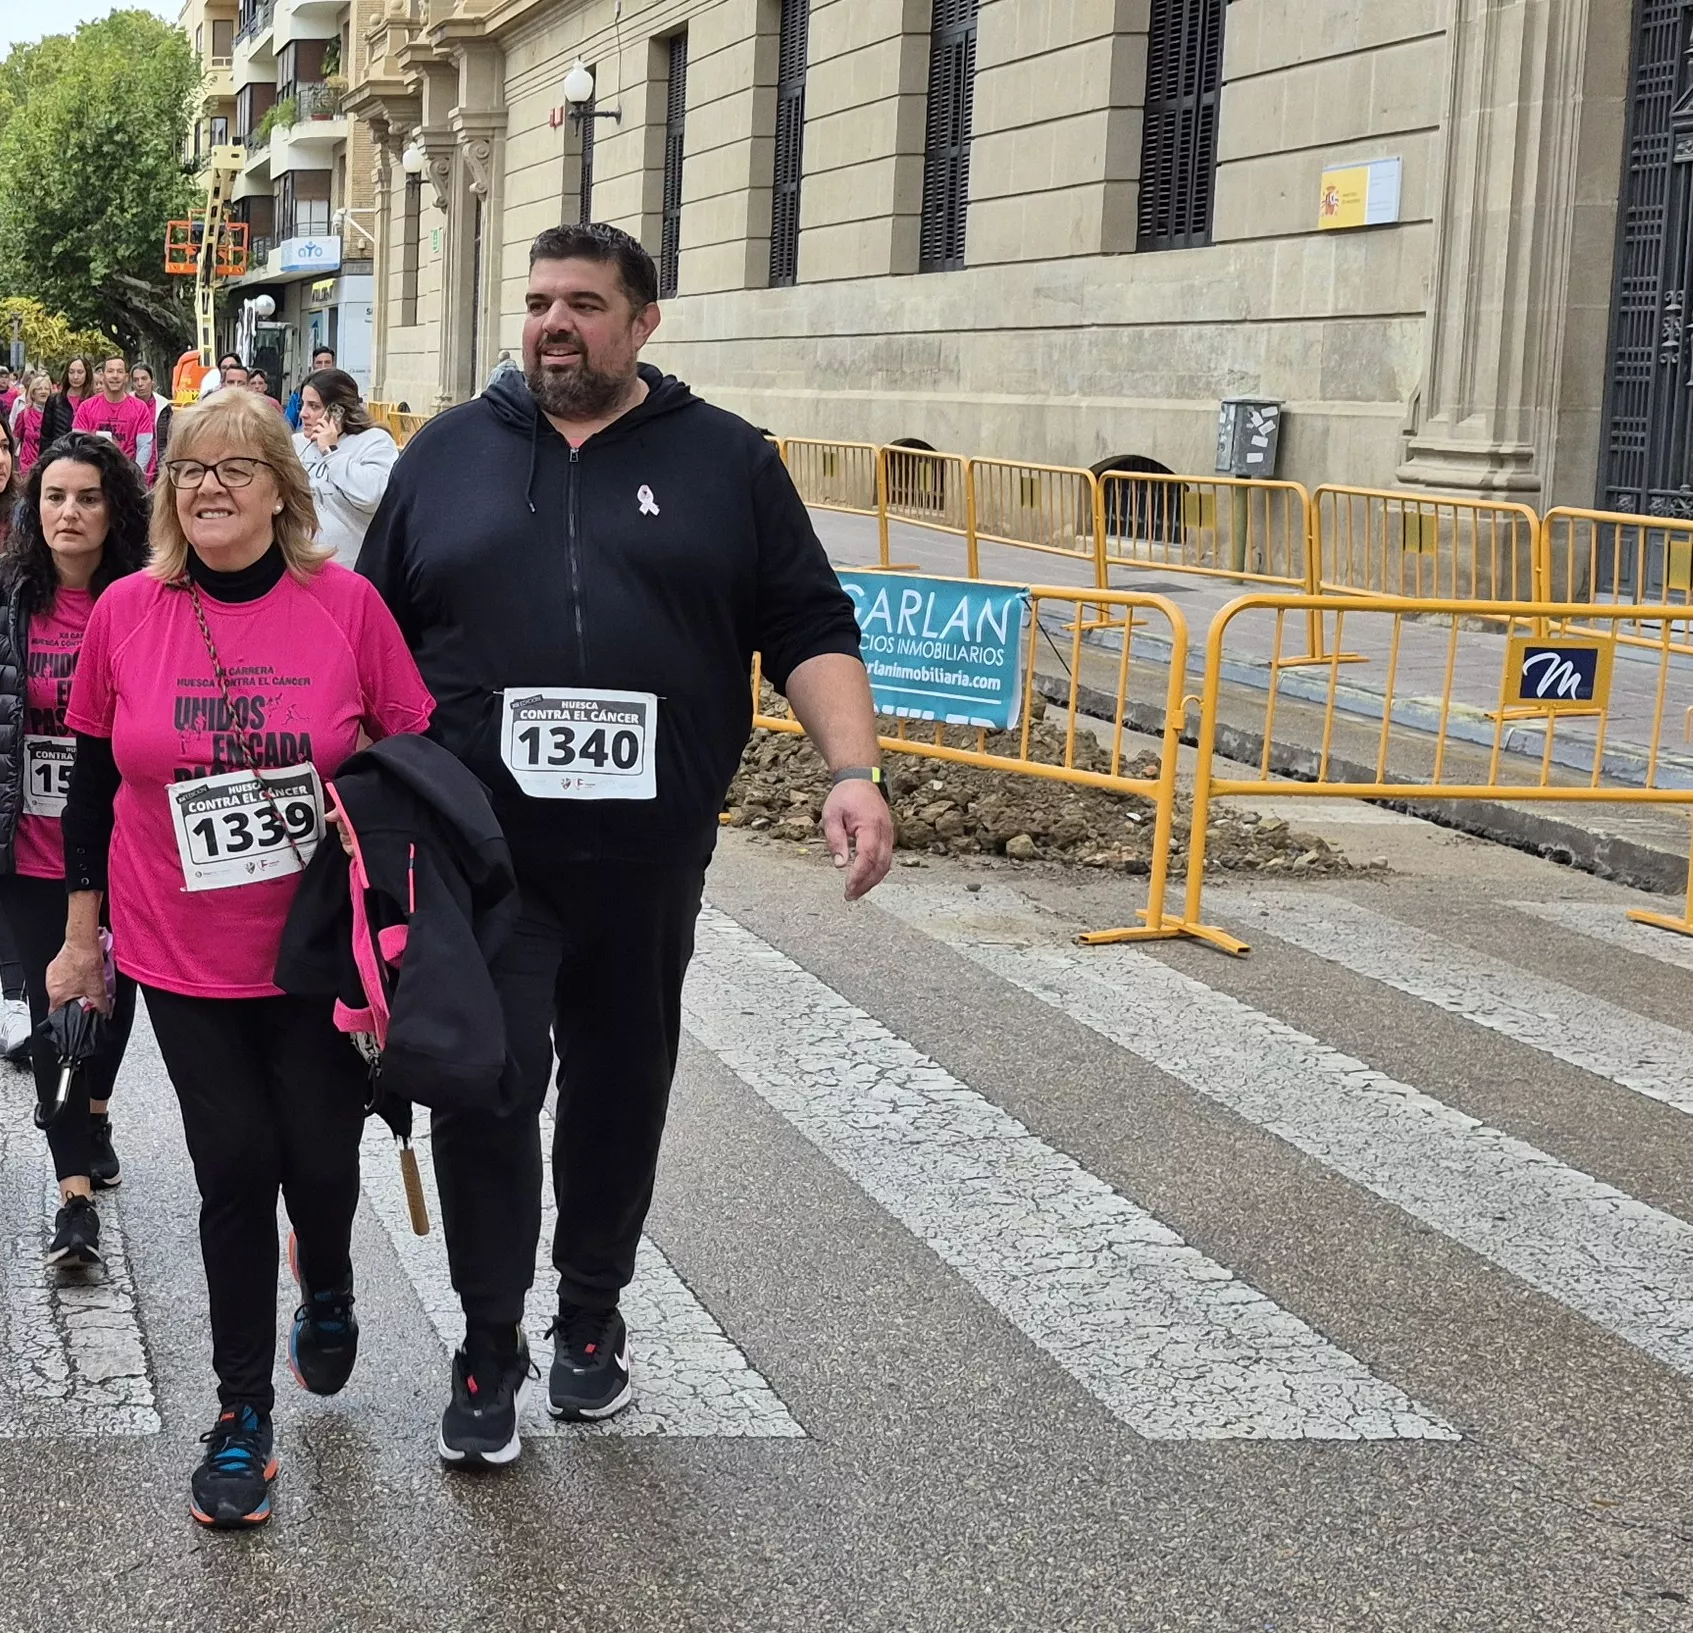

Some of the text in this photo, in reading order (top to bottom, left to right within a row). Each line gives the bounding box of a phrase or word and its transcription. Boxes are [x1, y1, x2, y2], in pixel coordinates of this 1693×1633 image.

[859, 634, 1005, 666] CIOS INMOBILIARIOS
[28, 652, 79, 678] UNID
[228, 666, 274, 677] CARRERA
[865, 660, 1001, 690] rlaninmobiliaria.com
[177, 678, 215, 688] HUESCA
[259, 677, 270, 686] EL
[272, 675, 311, 686] CÁNCER
[174, 695, 266, 731] UNIDOS
[520, 708, 639, 724] CONTRA EL CÁNCER
[561, 700, 599, 710] HUESCA
[35, 750, 75, 761] CONTRA
[213, 731, 314, 768] EN CADA
[518, 726, 639, 770] 1340
[35, 763, 72, 795] 15
[228, 782, 261, 795] HUESC
[188, 796, 240, 813] CONTRA
[242, 792, 258, 804] EL
[192, 801, 315, 857] 1339
